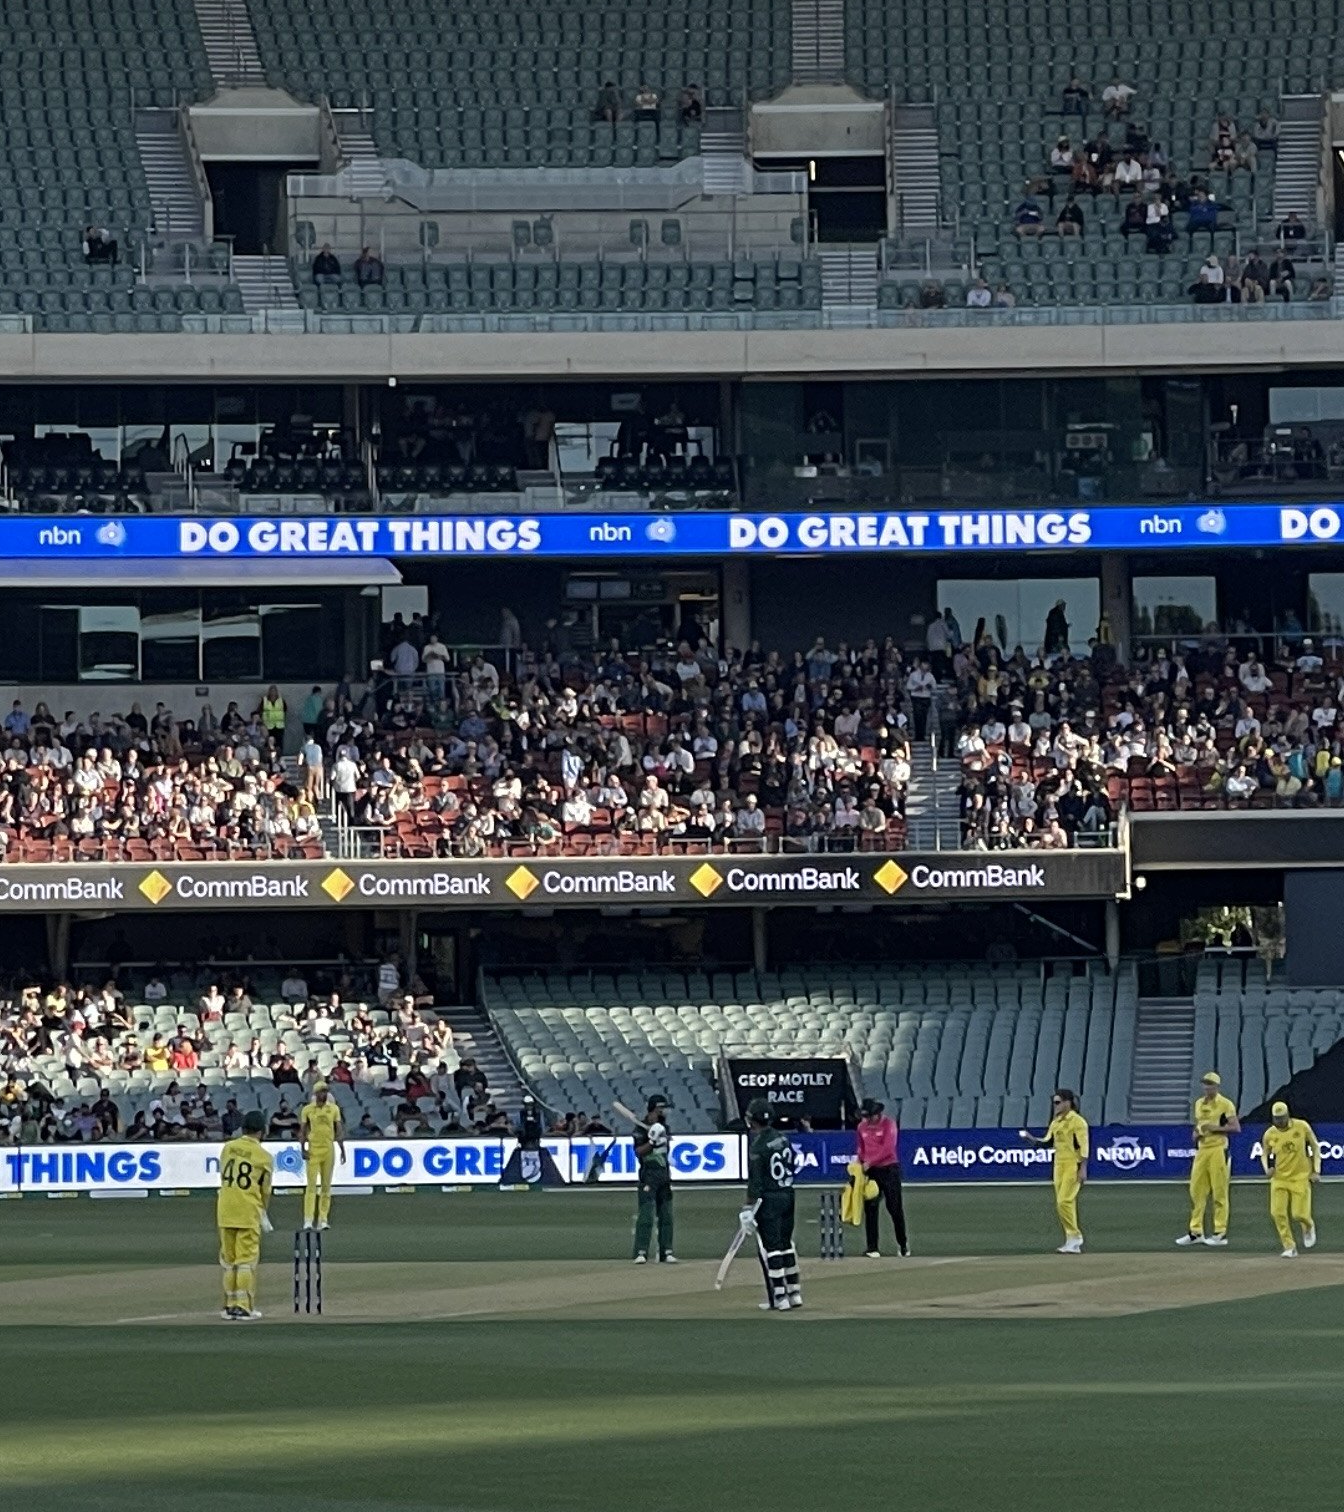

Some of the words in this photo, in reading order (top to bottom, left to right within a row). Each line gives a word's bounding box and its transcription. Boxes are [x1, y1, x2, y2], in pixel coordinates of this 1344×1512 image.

[590, 522, 632, 542] nbn
[729, 516, 789, 549] DO
[797, 515, 929, 548] GREAT
[938, 512, 1092, 546] THINGS
[1140, 514, 1183, 534] nbn
[1280, 507, 1341, 539] DO
[39, 525, 81, 545] nbn
[180, 521, 240, 553] DO
[248, 521, 379, 553] GREAT
[388, 519, 541, 552] THINGS
[176, 875, 309, 898] CommBank
[359, 872, 491, 896] CommBank
[543, 870, 676, 893] CommBank
[726, 867, 860, 891] CommBank
[911, 864, 1045, 888] CommBank
[738, 1073, 776, 1087] GEOF
[778, 1073, 833, 1087] MOTLEY
[767, 1090, 804, 1104] RACE
[353, 1146, 413, 1178] DO
[913, 1147, 930, 1165] A
[931, 1146, 977, 1168] Help
[1096, 1147, 1156, 1161] NRMA
[6, 1150, 162, 1185] THINGS
[222, 1157, 252, 1190] 48
